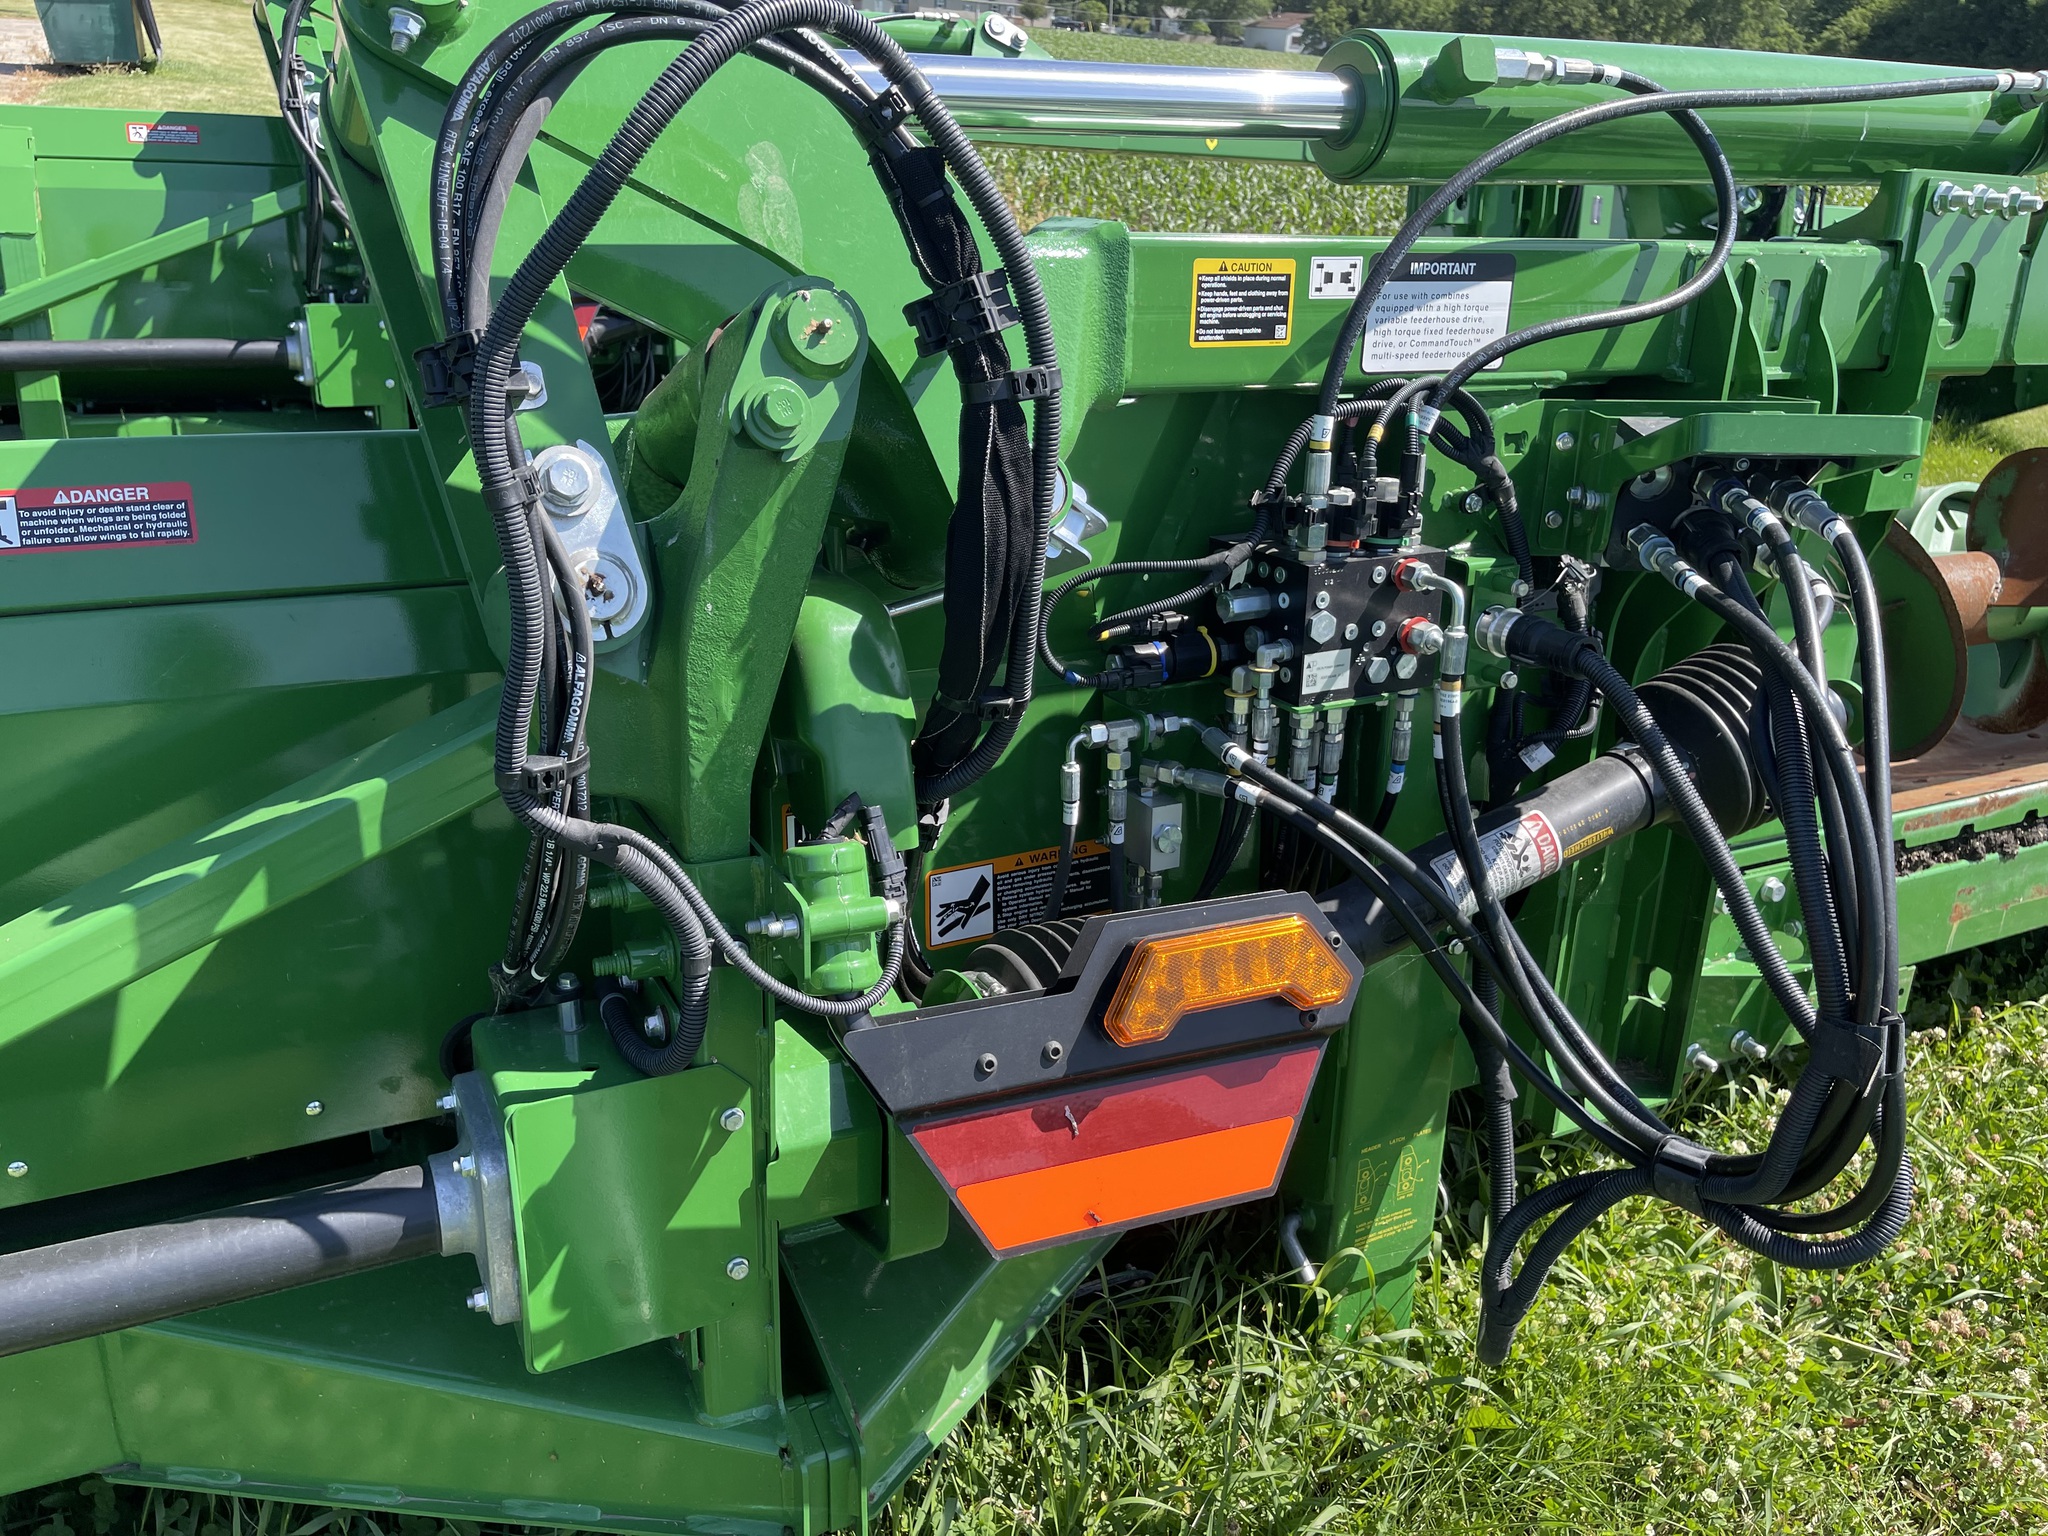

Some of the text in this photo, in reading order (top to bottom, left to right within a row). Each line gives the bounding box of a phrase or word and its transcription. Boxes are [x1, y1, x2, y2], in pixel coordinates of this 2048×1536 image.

[556, 4, 572, 19] 22
[450, 57, 491, 122] ALFAGOMMA
[468, 89, 493, 139] exceeds
[466, 175, 479, 237] exceeds
[504, 76, 524, 102] R17
[542, 48, 560, 63] EN
[566, 31, 589, 48] 857
[442, 129, 458, 157] AT3K
[460, 141, 475, 166] SAE
[456, 169, 466, 189] 100
[436, 160, 451, 249] MINETUFF-1B-04
[452, 192, 463, 217] R17
[1231, 263, 1272, 272] CAUTION
[1410, 262, 1476, 275] IMPORTANT
[1376, 305, 1413, 314] equipped
[1444, 304, 1461, 313] high
[1464, 304, 1489, 314] torque
[1462, 316, 1485, 324] drive,
[1374, 327, 1494, 338] high torque fixed feederhouse
[1372, 340, 1396, 349] drive,
[1371, 352, 1419, 361] multi-speed
[70, 487, 149, 504] DANGER
[18, 510, 30, 518] To
[32, 508, 57, 517] avoid
[59, 507, 84, 517] injury
[99, 505, 124, 514] death
[126, 503, 150, 511] stand
[20, 517, 58, 527] machine
[60, 516, 85, 525] when
[86, 515, 114, 524] wings
[132, 512, 157, 522] being
[159, 510, 186, 519] folded
[34, 526, 77, 535] unfolded.
[79, 523, 131, 533] Mechanical
[146, 520, 188, 530] hydraulic
[22, 536, 52, 546] failure
[73, 534, 98, 542] allow
[99, 531, 127, 541] wings
[129, 531, 139, 539] to
[140, 530, 155, 538] fall
[157, 528, 190, 538] rapidly.
[563, 666, 587, 743] ALFAGOMMA
[525, 832, 539, 858] ITALY
[546, 839, 556, 850] 1B
[1029, 845, 1087, 863] WARNG
[1536, 832, 1555, 878] DANGE
[523, 865, 530, 875] IN
[1490, 856, 1503, 876] KEEP
[542, 871, 551, 884] WP
[517, 881, 528, 899] MADE
[540, 883, 549, 899] 22.5
[537, 895, 547, 910] MPa
[1389, 1136, 1405, 1145] LATCH
